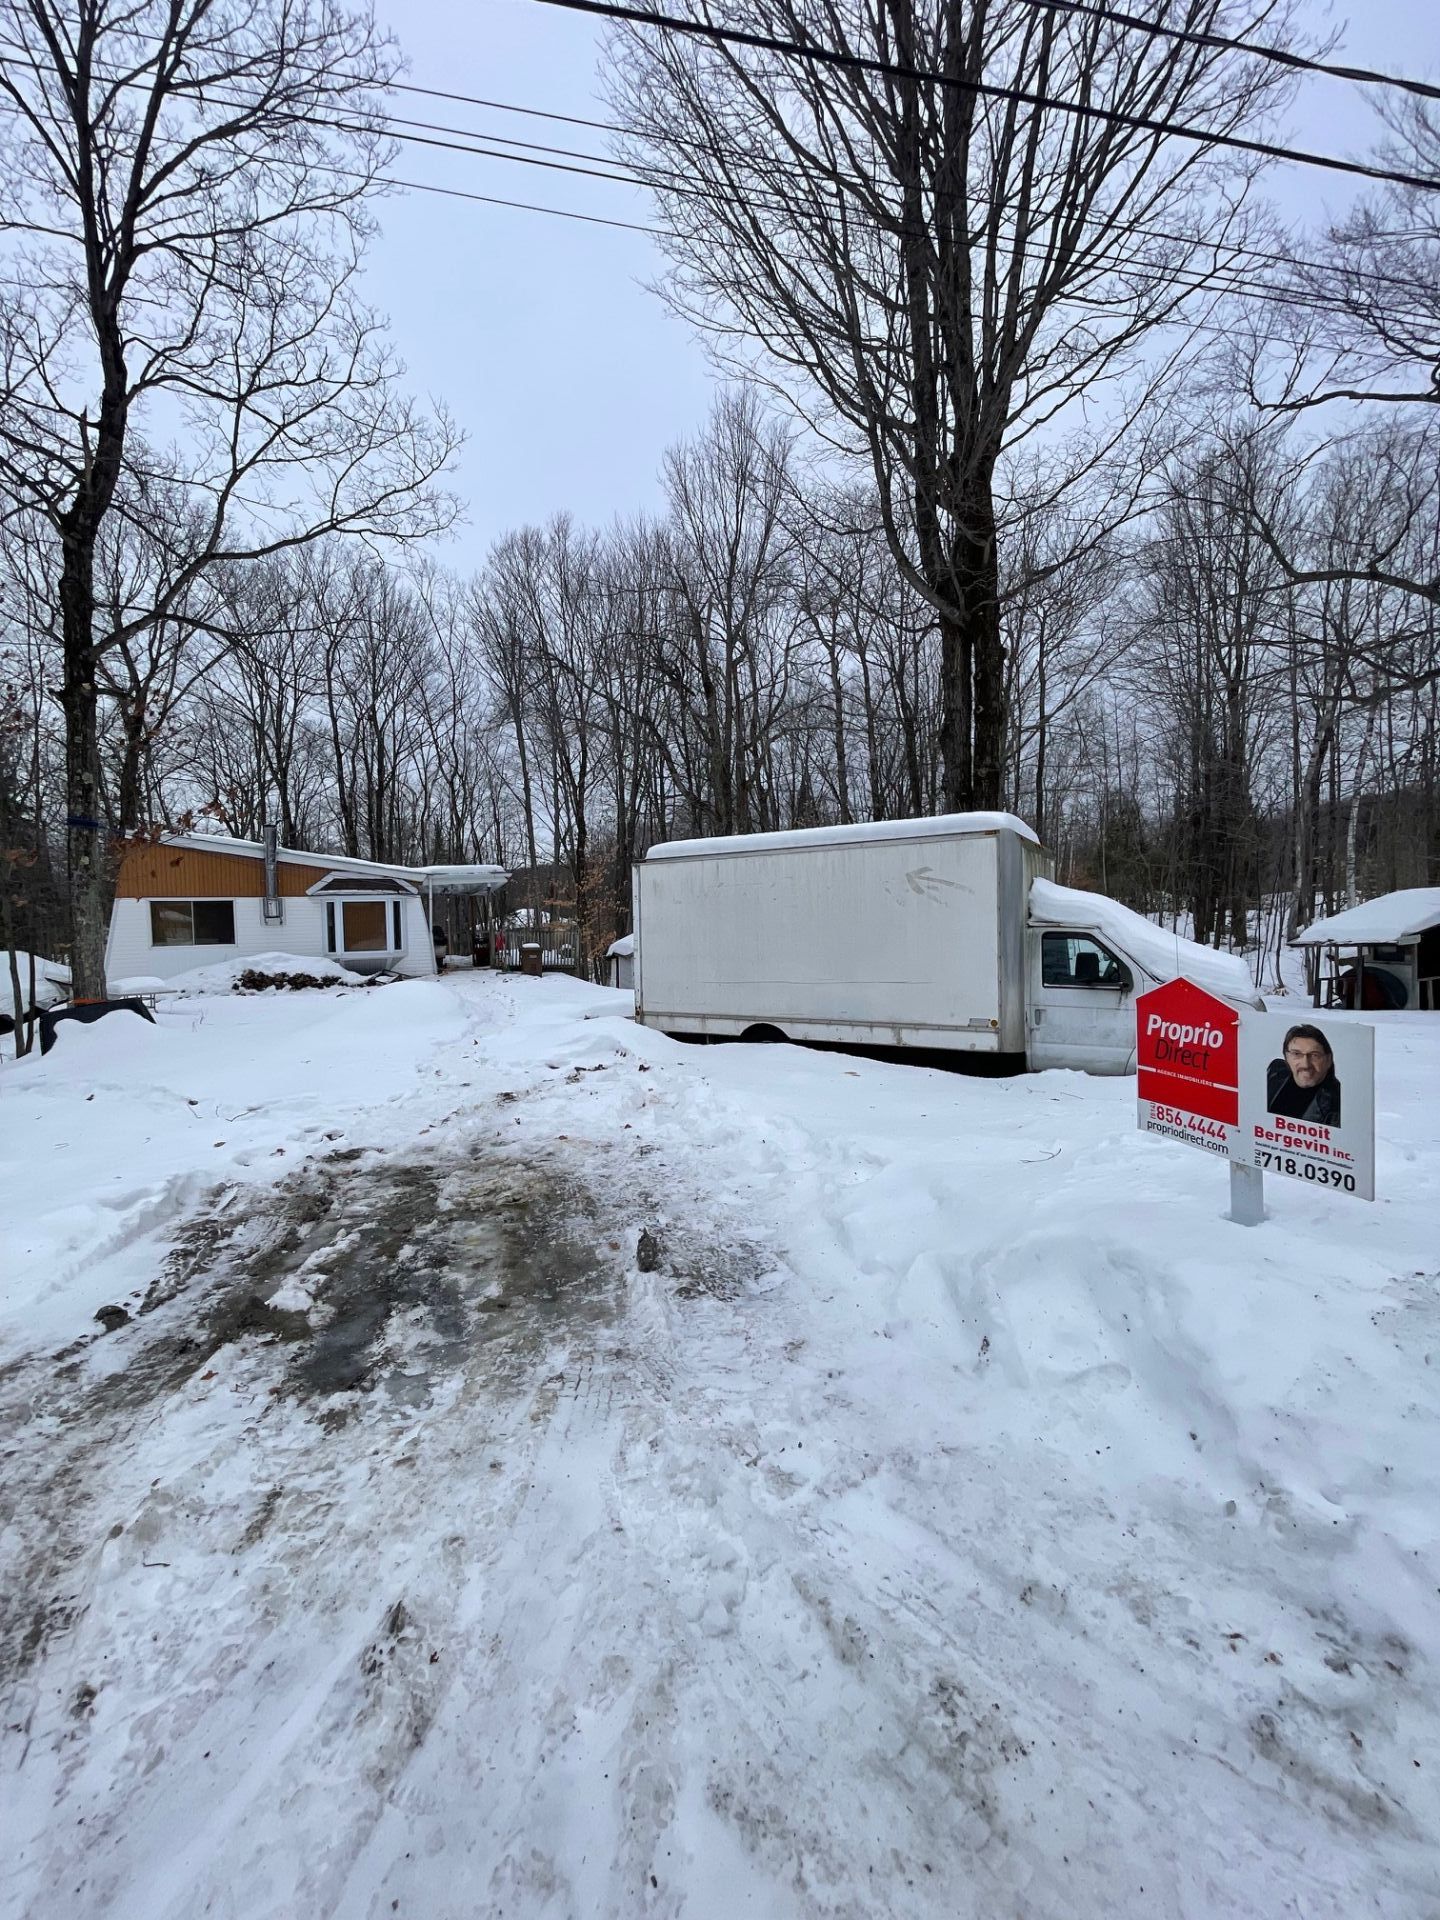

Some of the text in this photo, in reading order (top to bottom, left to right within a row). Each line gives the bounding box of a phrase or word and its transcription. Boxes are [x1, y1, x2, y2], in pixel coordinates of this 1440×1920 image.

[1146, 1013, 1223, 1049] Proprio
[1155, 1039, 1210, 1071] Direct
[1147, 1120, 1229, 1154] propriodirect.com
[1156, 1105, 1227, 1141] 856.4444
[1275, 1116, 1331, 1140] Benoit
[1254, 1125, 1329, 1155] Bergevin
[1333, 1148, 1355, 1162] inc.
[1262, 1151, 1356, 1192] 718.0390
